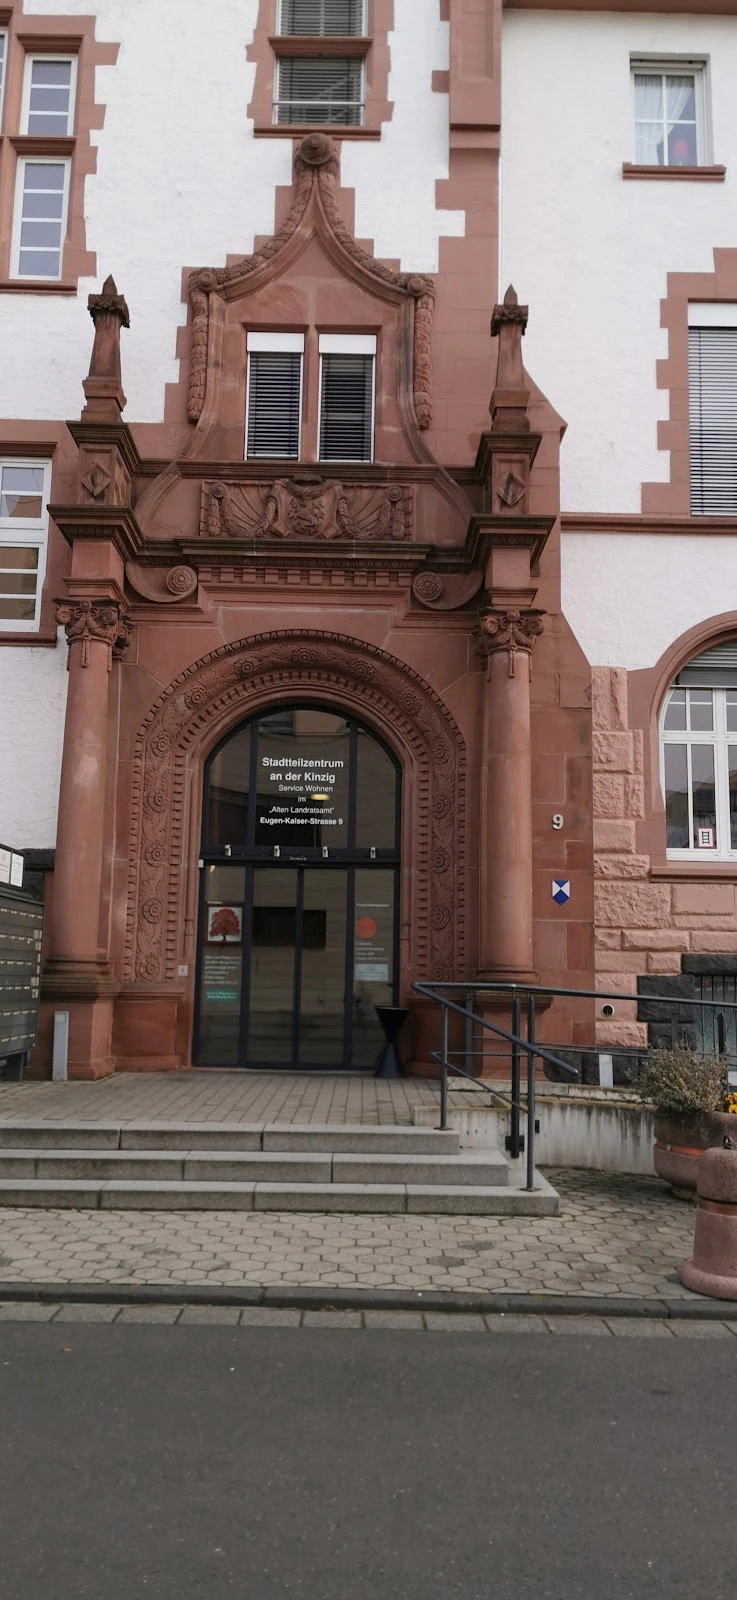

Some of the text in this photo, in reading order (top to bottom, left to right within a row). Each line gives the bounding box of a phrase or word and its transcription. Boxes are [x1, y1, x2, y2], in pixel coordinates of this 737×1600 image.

[262, 757, 344, 768] Stadtteilzentrum
[270, 772, 335, 783] an der Kinzig
[278, 784, 333, 793] Service Wohnen
[260, 817, 337, 825] Eugen-Kaiser-Strasse
[551, 813, 564, 830] 9
